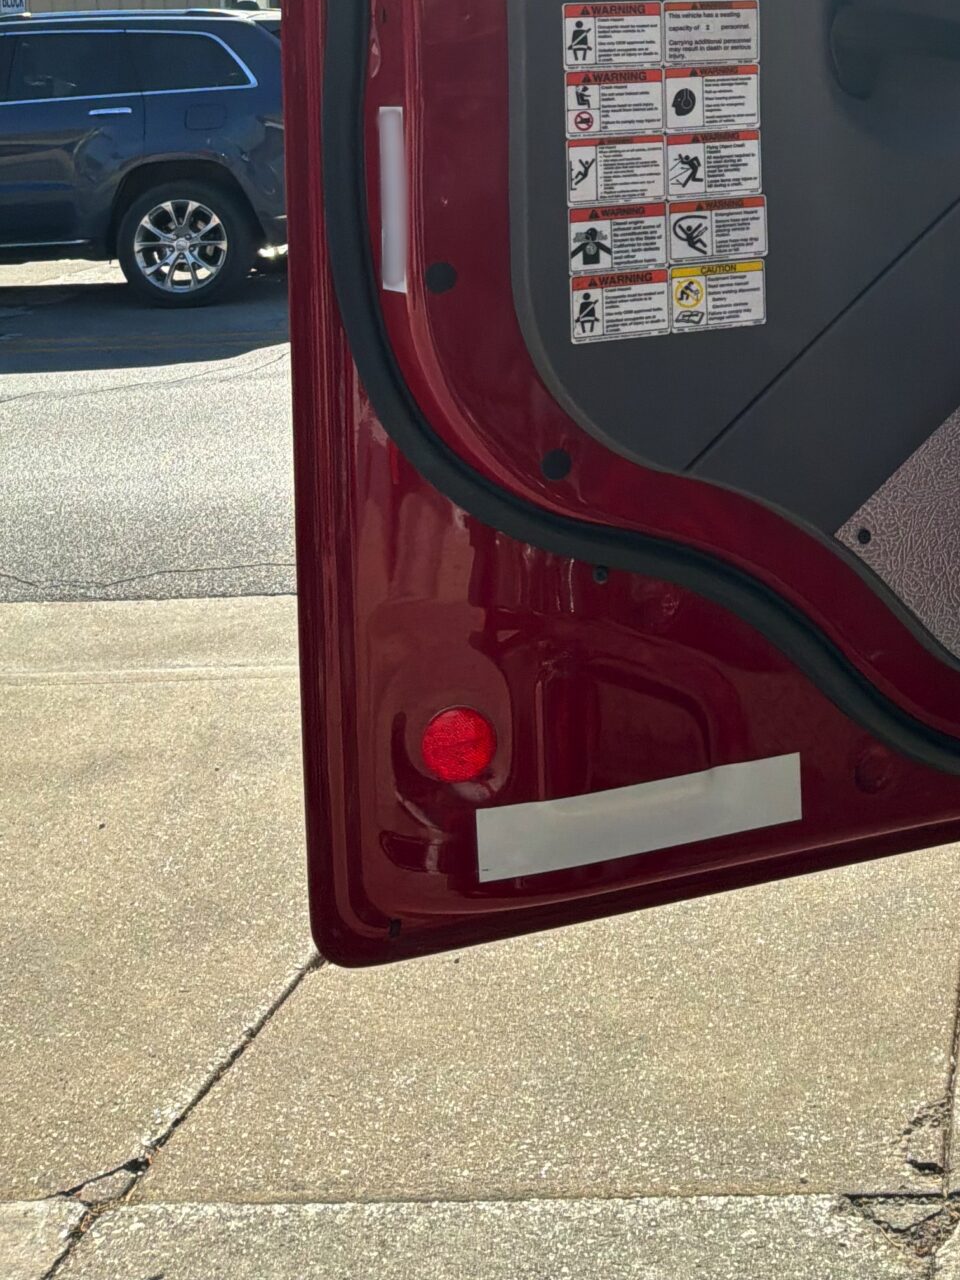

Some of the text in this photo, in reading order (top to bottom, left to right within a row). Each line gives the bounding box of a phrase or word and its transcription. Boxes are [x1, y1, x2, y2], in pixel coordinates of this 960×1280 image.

[592, 4, 646, 15] WARNING
[593, 71, 647, 81] WARNING
[701, 264, 736, 275] CAUTION
[599, 272, 653, 285] WARNING
